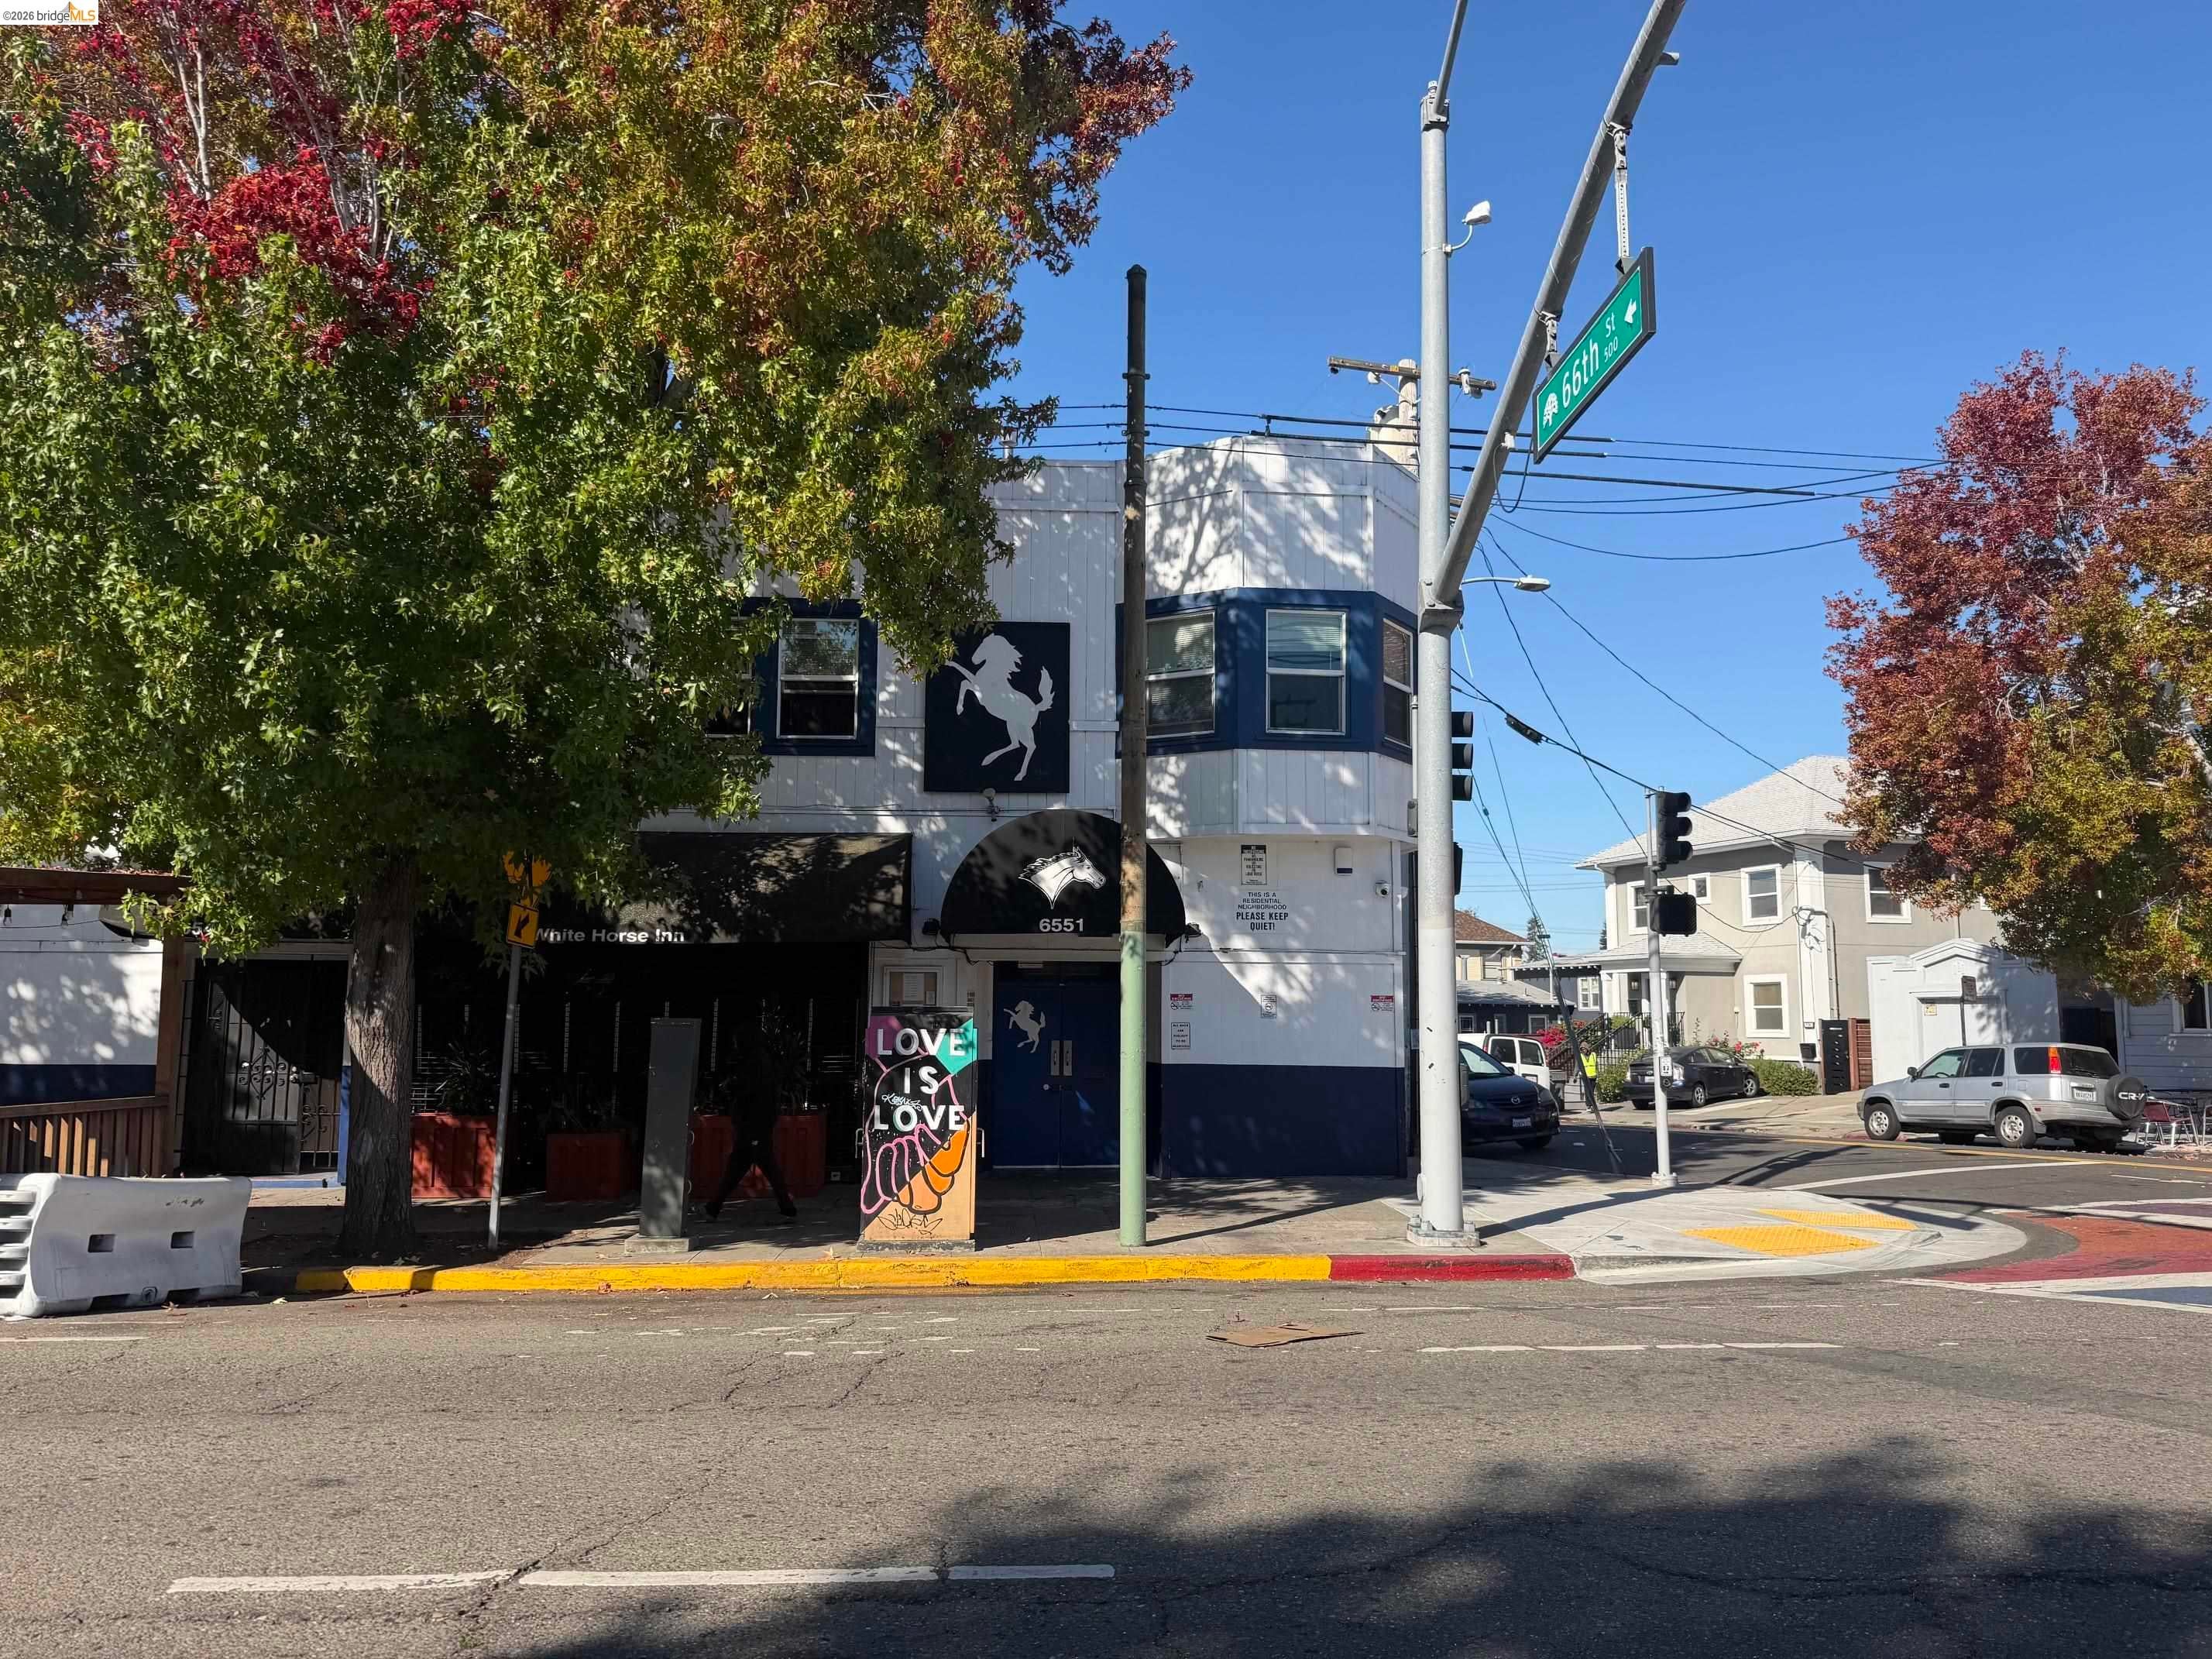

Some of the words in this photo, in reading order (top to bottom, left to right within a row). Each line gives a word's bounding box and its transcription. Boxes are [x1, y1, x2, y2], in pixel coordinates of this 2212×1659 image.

[1604, 336, 1618, 362] 500
[1562, 338, 1599, 408] 66th
[1606, 312, 1615, 338] St
[1039, 918, 1084, 933] 6551
[1236, 912, 1266, 920] PLEASE
[1269, 912, 1289, 921] KEEP
[1250, 922, 1276, 931] QUIET!
[535, 928, 586, 943] White
[592, 929, 649, 943] Horse
[655, 929, 685, 943] Inn
[876, 1028, 965, 1056] LOVE
[903, 1066, 939, 1094] IS
[2118, 1092, 2145, 1101] CR-V
[873, 1104, 965, 1132] LOVE
